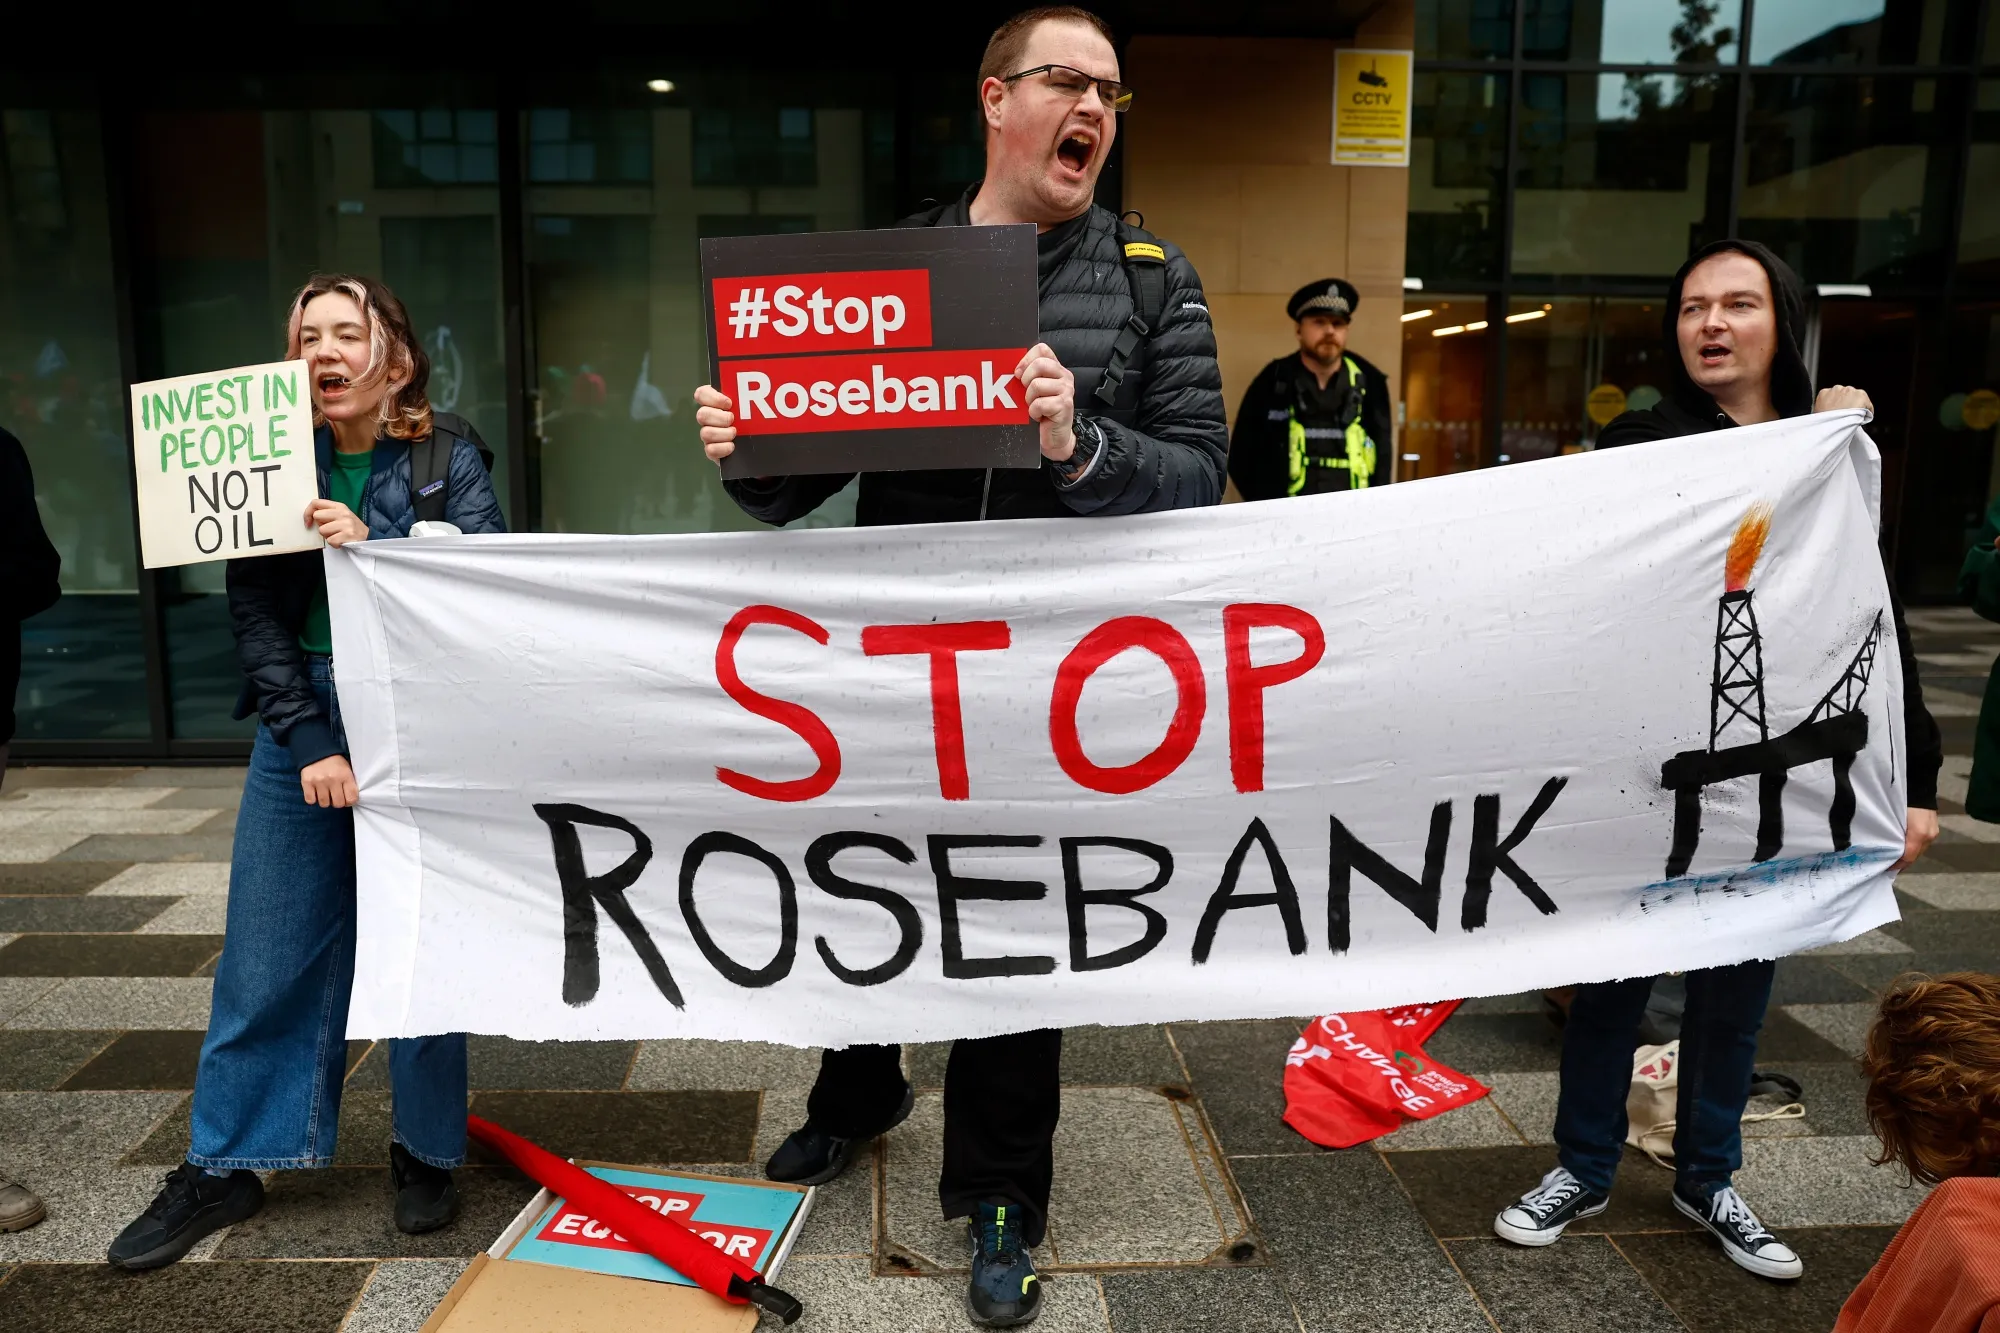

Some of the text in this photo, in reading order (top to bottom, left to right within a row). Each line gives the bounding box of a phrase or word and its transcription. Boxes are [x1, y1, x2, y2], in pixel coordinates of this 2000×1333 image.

[1352, 92, 1392, 105] CCTV
[728, 285, 906, 346] #Stop
[142, 370, 298, 431] INVEST IN
[735, 360, 1019, 421] Rosebank
[160, 414, 292, 473] PEOPLE
[188, 464, 281, 514] NOT
[194, 511, 274, 554] OIL
[715, 603, 1325, 803] STOP
[532, 775, 1570, 1011] ROSEBANK
